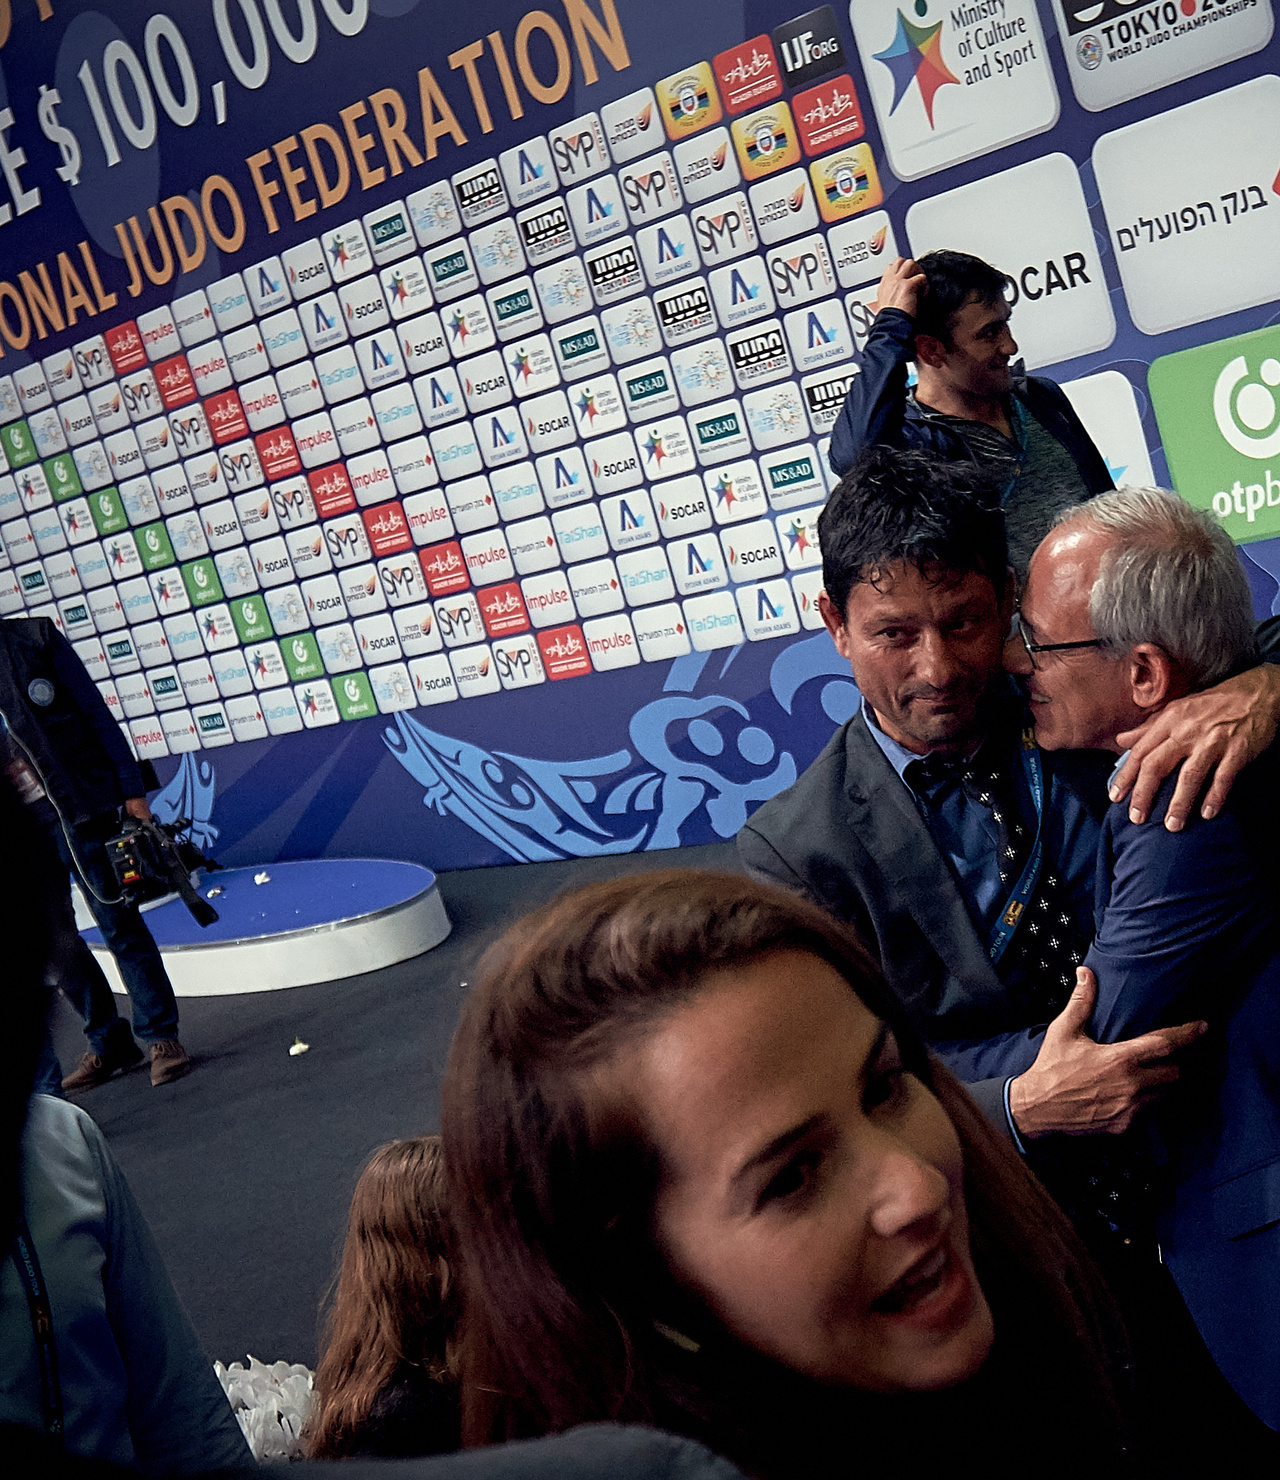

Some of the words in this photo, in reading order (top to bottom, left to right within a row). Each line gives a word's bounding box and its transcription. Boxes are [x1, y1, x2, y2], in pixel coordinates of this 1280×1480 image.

[958, 36, 973, 59] of
[974, 16, 1028, 53] Culture
[1101, 8, 1180, 48] TOKYO
[1107, 44, 1142, 63] WORLD
[1145, 35, 1172, 54] JUDO
[964, 58, 991, 86] and
[996, 41, 1038, 78] Sport
[113, 174, 247, 298] JUDO
[245, 0, 632, 234] FEDERATION
[1220, 183, 1269, 225] בנק
[1115, 201, 1218, 252] הפועלים
[298, 262, 325, 282] SOCAR
[355, 299, 383, 318] SOCAR
[414, 336, 444, 356] SOCAR
[475, 375, 505, 395] SOCAR
[241, 393, 278, 415] impulse
[538, 416, 570, 435] SOCAR
[295, 430, 332, 450] impulse
[603, 457, 636, 476] SOCAR
[349, 468, 388, 487] impulse
[406, 507, 446, 526] impulse
[670, 501, 705, 519] SOCAR
[465, 547, 506, 566] impulse
[740, 546, 777, 564] SOCAR
[316, 596, 341, 611] SOCAR
[524, 589, 567, 608] impulse
[369, 635, 396, 650] SOCAR
[587, 633, 631, 653] impulse
[424, 676, 451, 690] SOCAR
